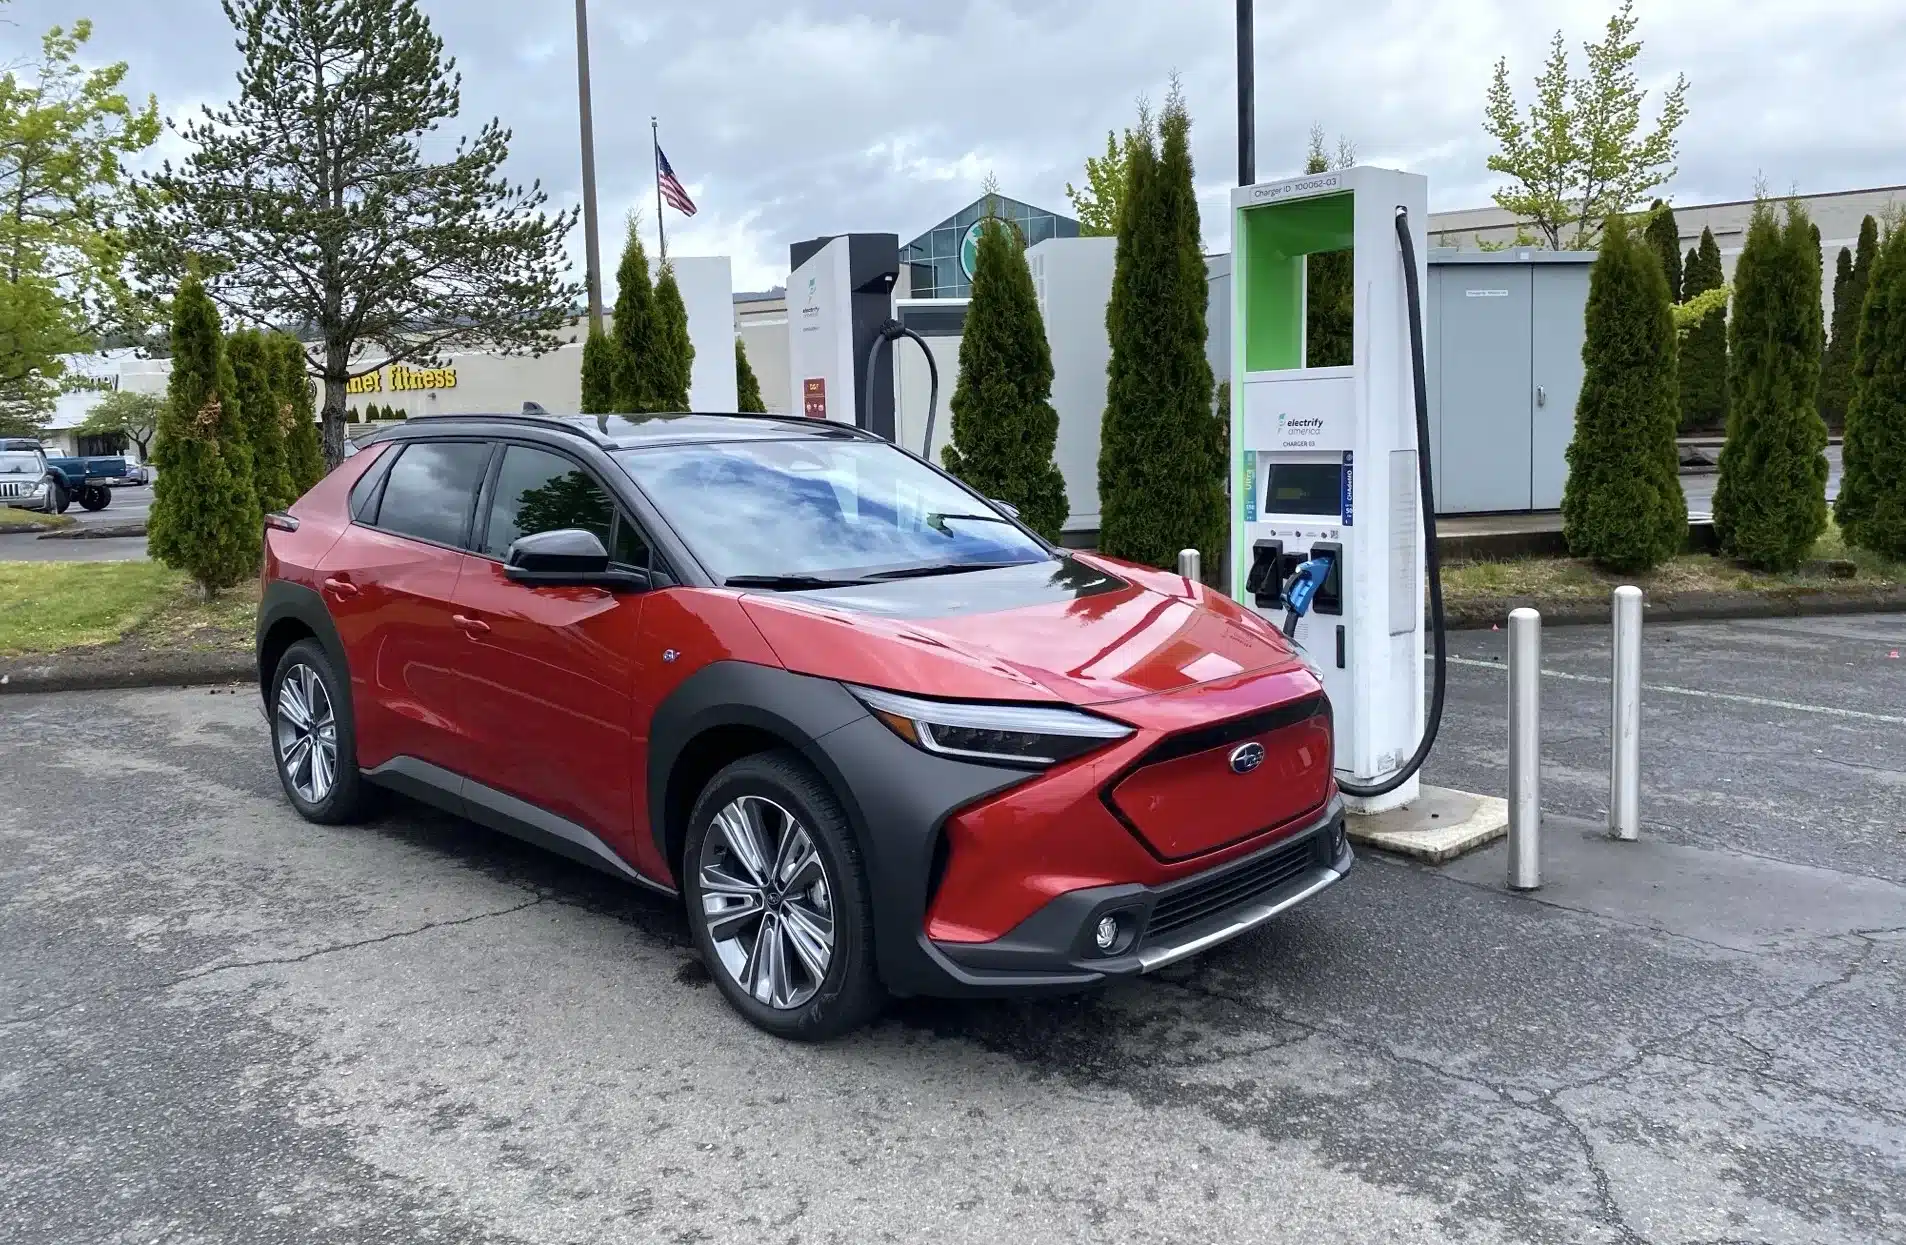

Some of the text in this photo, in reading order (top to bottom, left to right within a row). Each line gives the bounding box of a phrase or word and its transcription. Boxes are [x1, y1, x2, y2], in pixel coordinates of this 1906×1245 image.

[1255, 187, 1282, 198] Charger
[1295, 178, 1337, 191] 100062-03
[387, 363, 457, 392] fitness
[1287, 417, 1324, 428] electrify
[1288, 427, 1321, 436] america
[1244, 469, 1253, 490] Ultra
